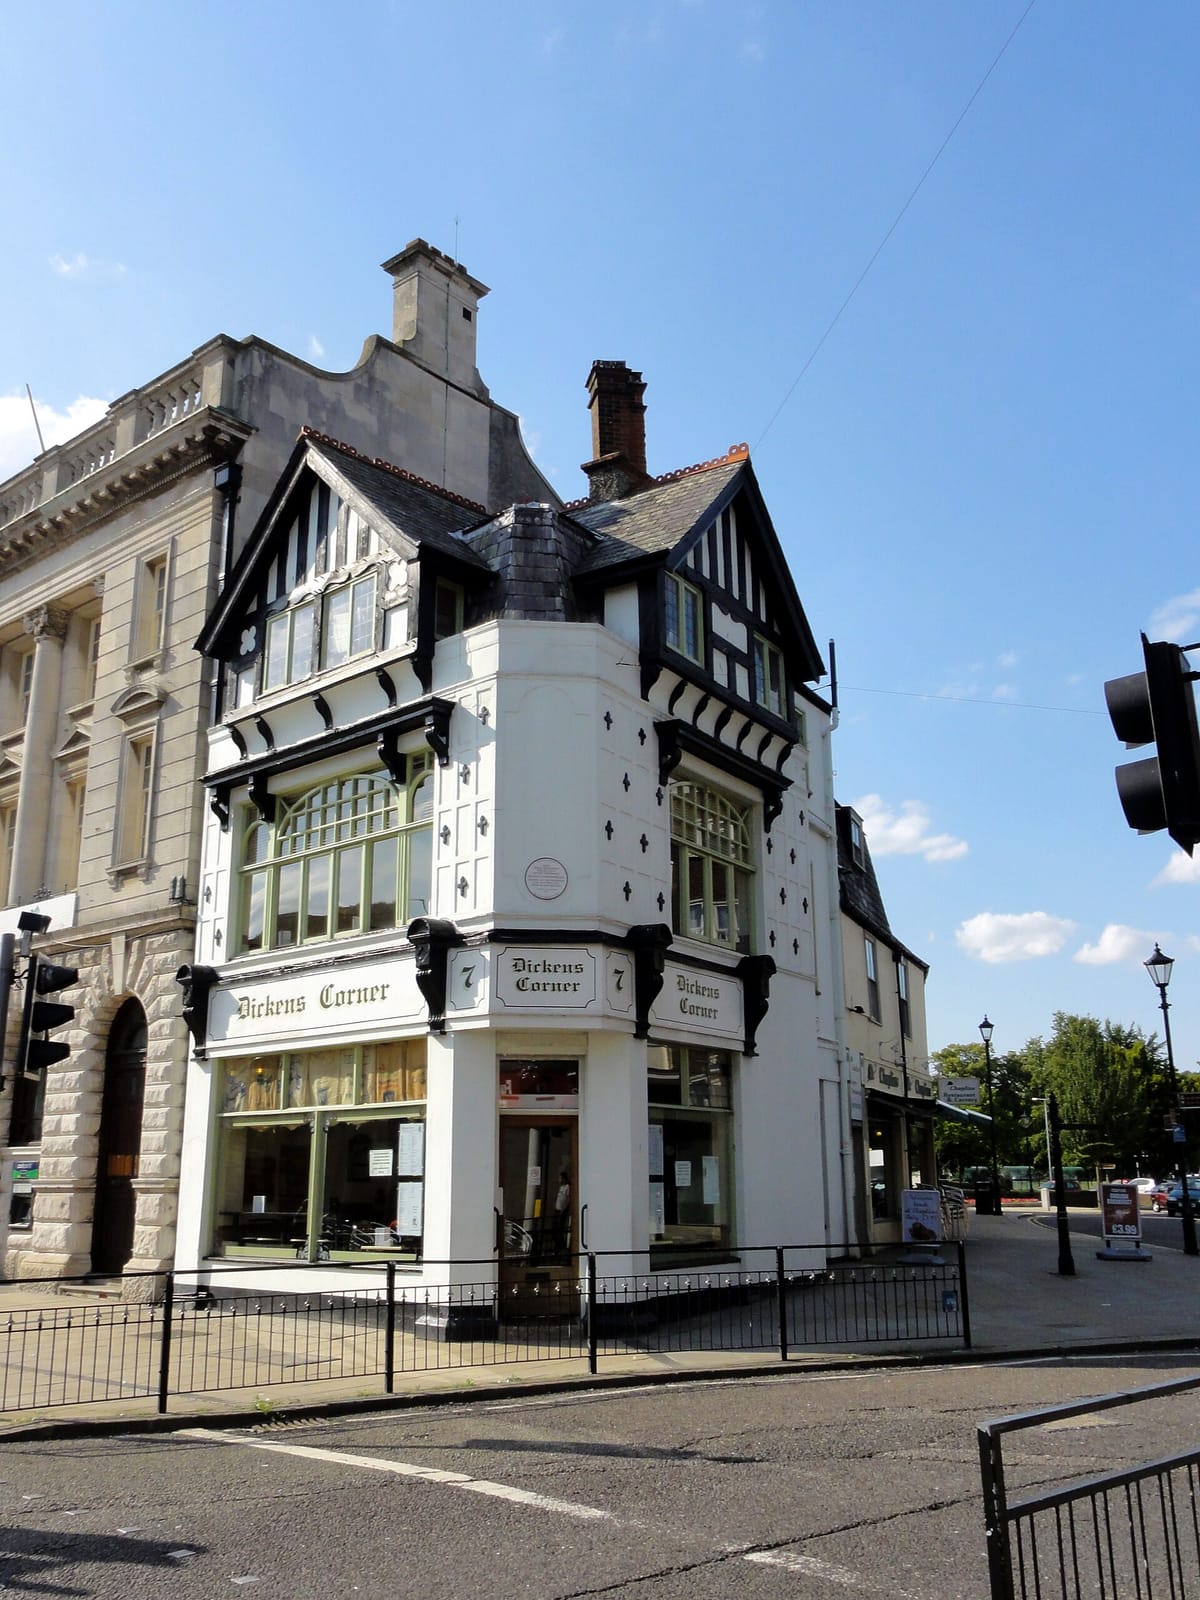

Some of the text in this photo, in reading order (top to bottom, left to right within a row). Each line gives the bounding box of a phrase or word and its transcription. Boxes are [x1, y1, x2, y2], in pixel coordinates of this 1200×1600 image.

[461, 965, 477, 989] 7
[512, 957, 585, 974] Dickens
[516, 977, 582, 992] Corner
[613, 968, 625, 992] 7
[676, 974, 720, 999] Dickens
[237, 983, 391, 1020] Dickens Corner
[679, 997, 719, 1020] Corner
